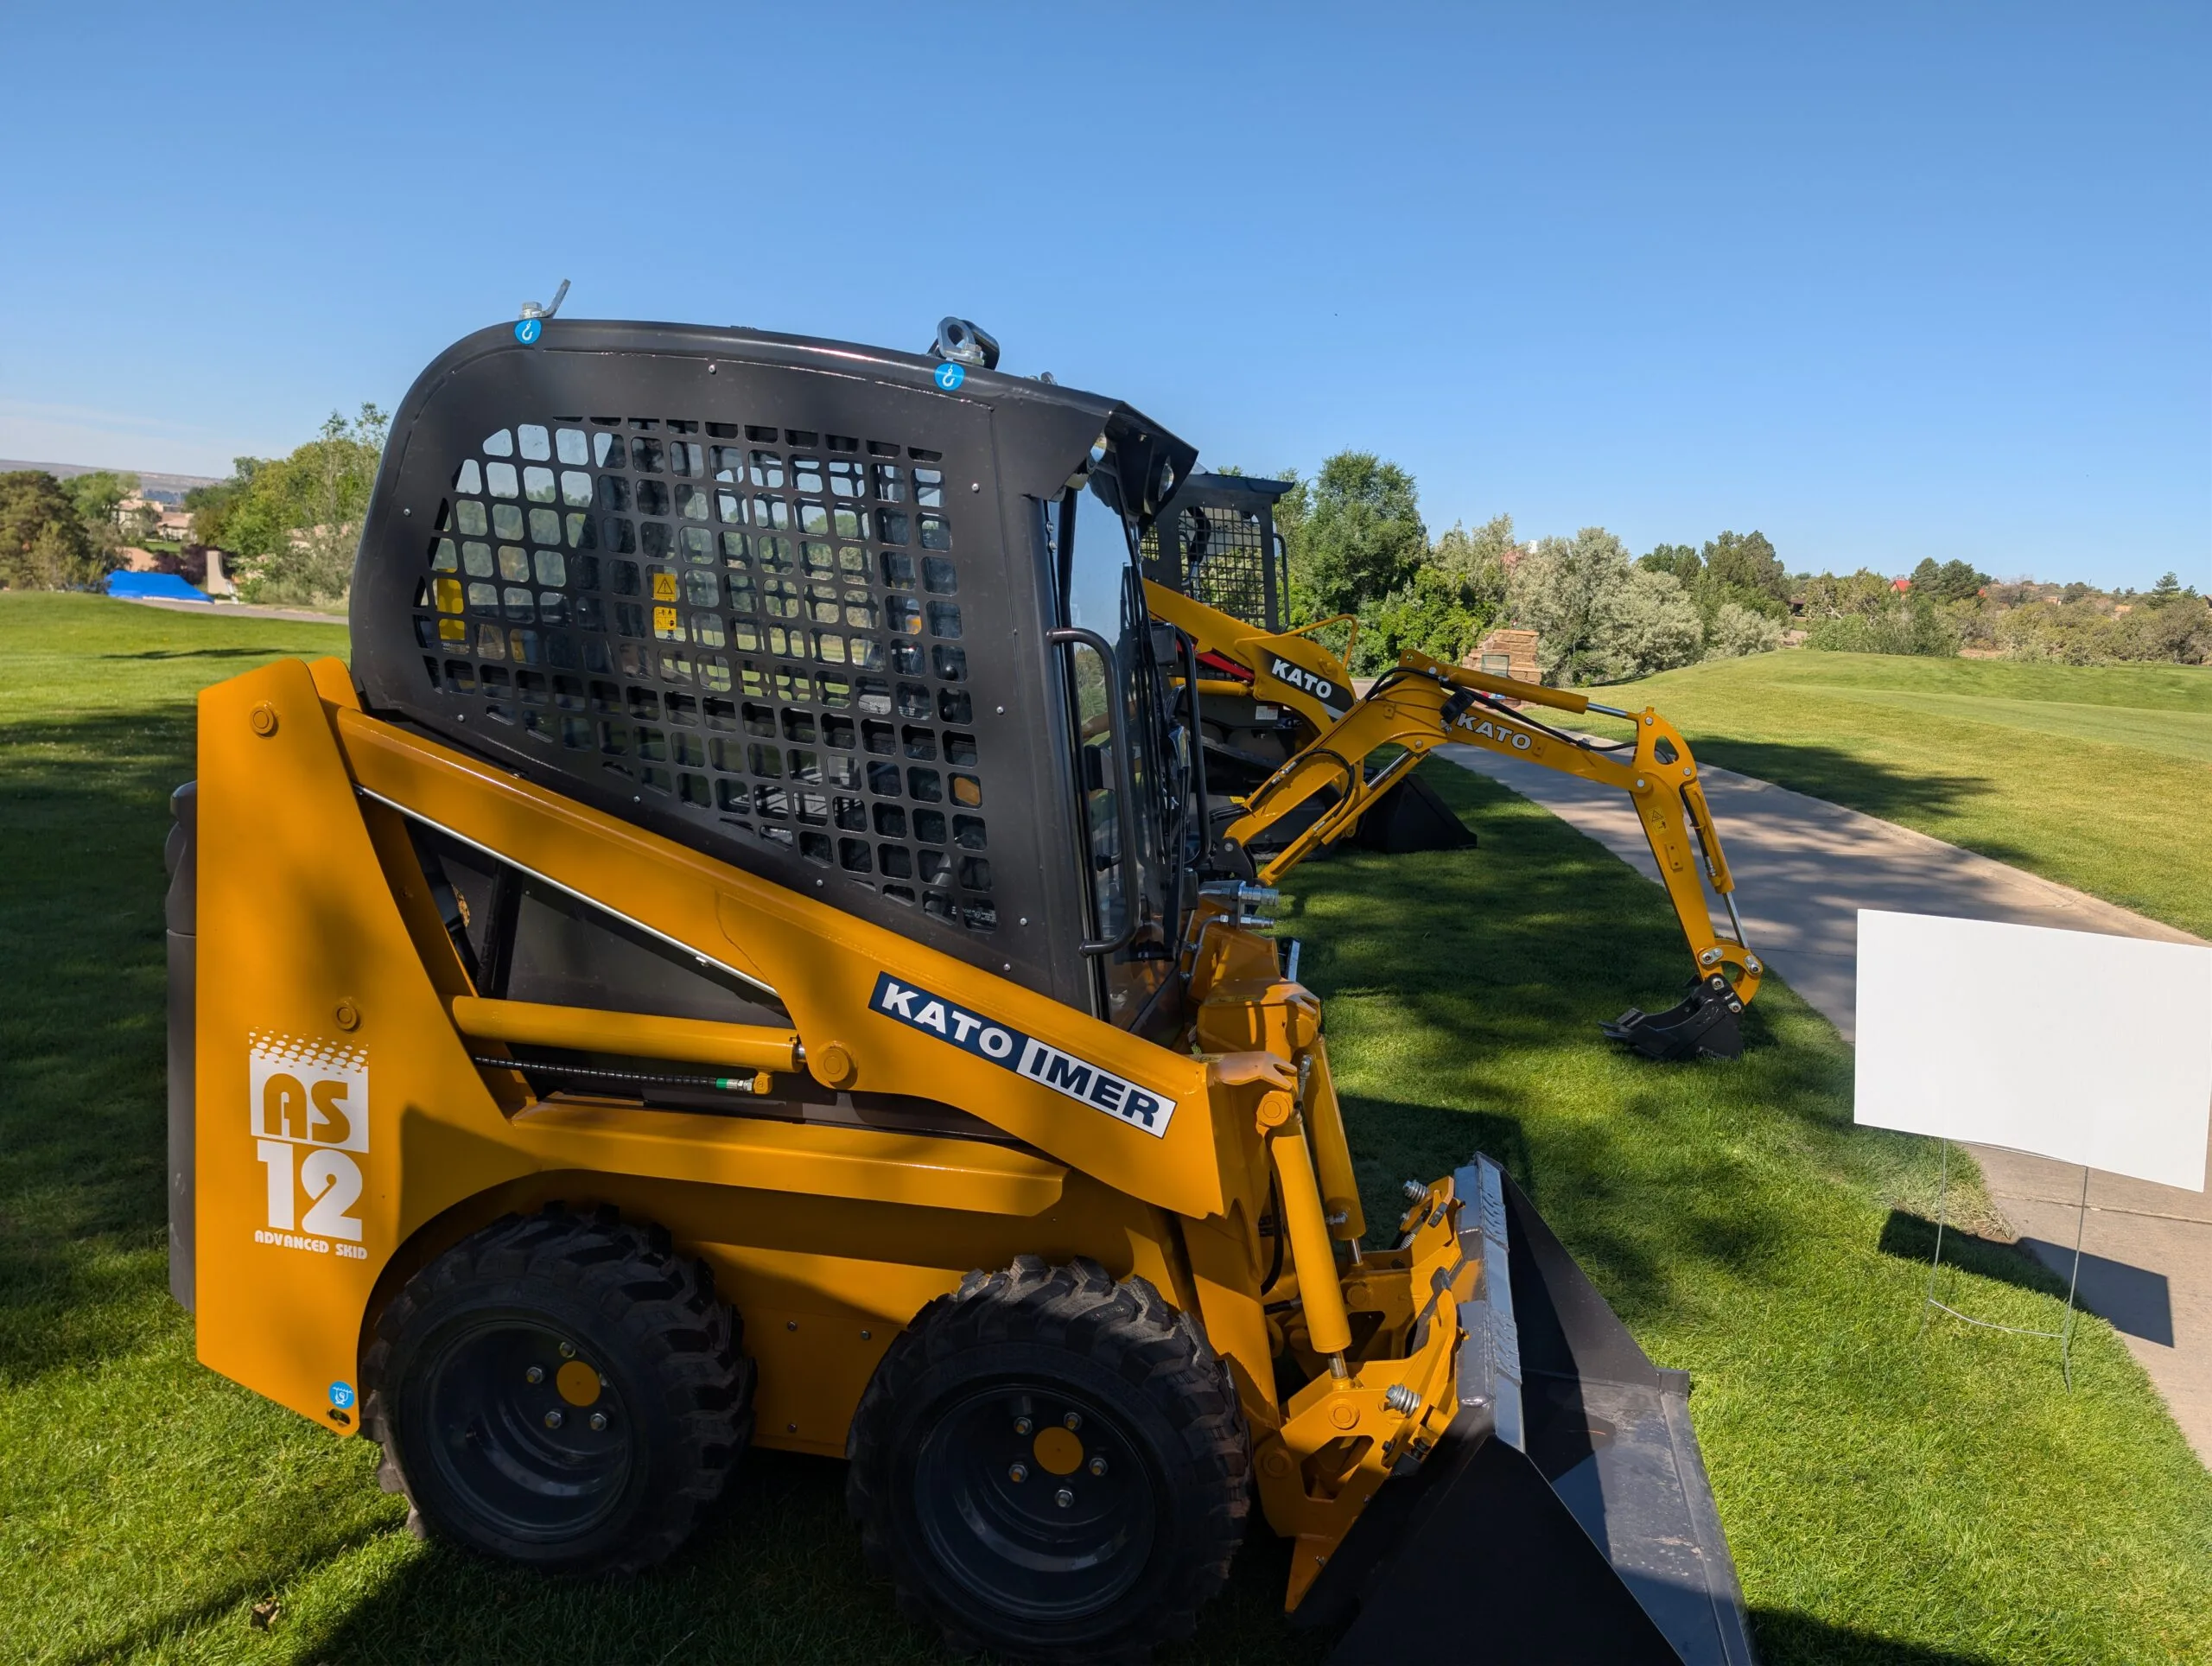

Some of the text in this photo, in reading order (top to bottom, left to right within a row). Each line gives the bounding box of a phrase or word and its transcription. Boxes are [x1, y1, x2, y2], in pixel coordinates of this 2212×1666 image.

[1271, 658, 1332, 698] KATO
[1455, 712, 1532, 751] KATO
[881, 982, 1160, 1129] KATO IMER
[263, 1072, 351, 1145] AS
[257, 1139, 363, 1242] 12
[254, 1230, 368, 1260] ADVANCED SKID
